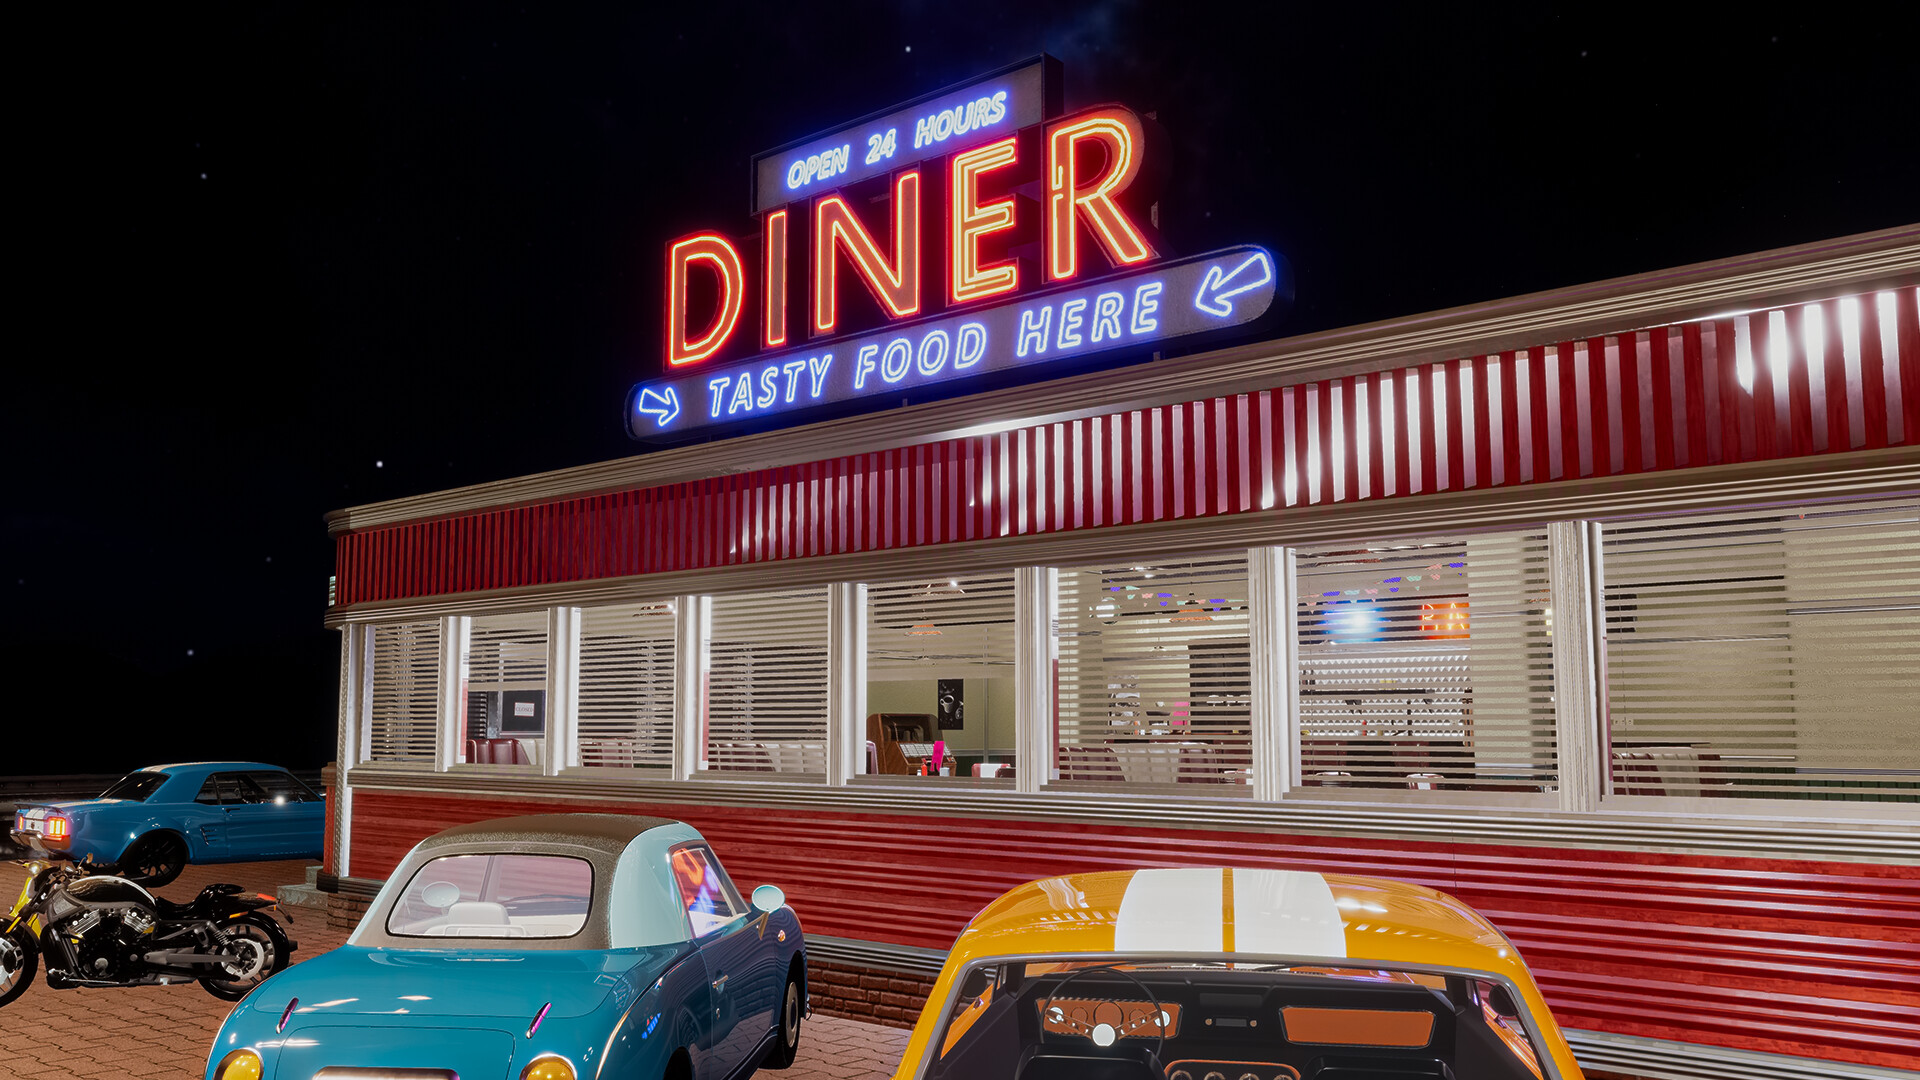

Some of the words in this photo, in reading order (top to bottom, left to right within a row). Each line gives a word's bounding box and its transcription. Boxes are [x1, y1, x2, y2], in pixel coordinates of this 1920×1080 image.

[787, 145, 849, 189] OPEN
[867, 129, 897, 165] 24
[914, 92, 1007, 148] HOURS
[667, 108, 1152, 367] DINER
[709, 355, 833, 418] TASTY
[854, 322, 988, 390] FOOD
[1016, 281, 1163, 358] HERE
